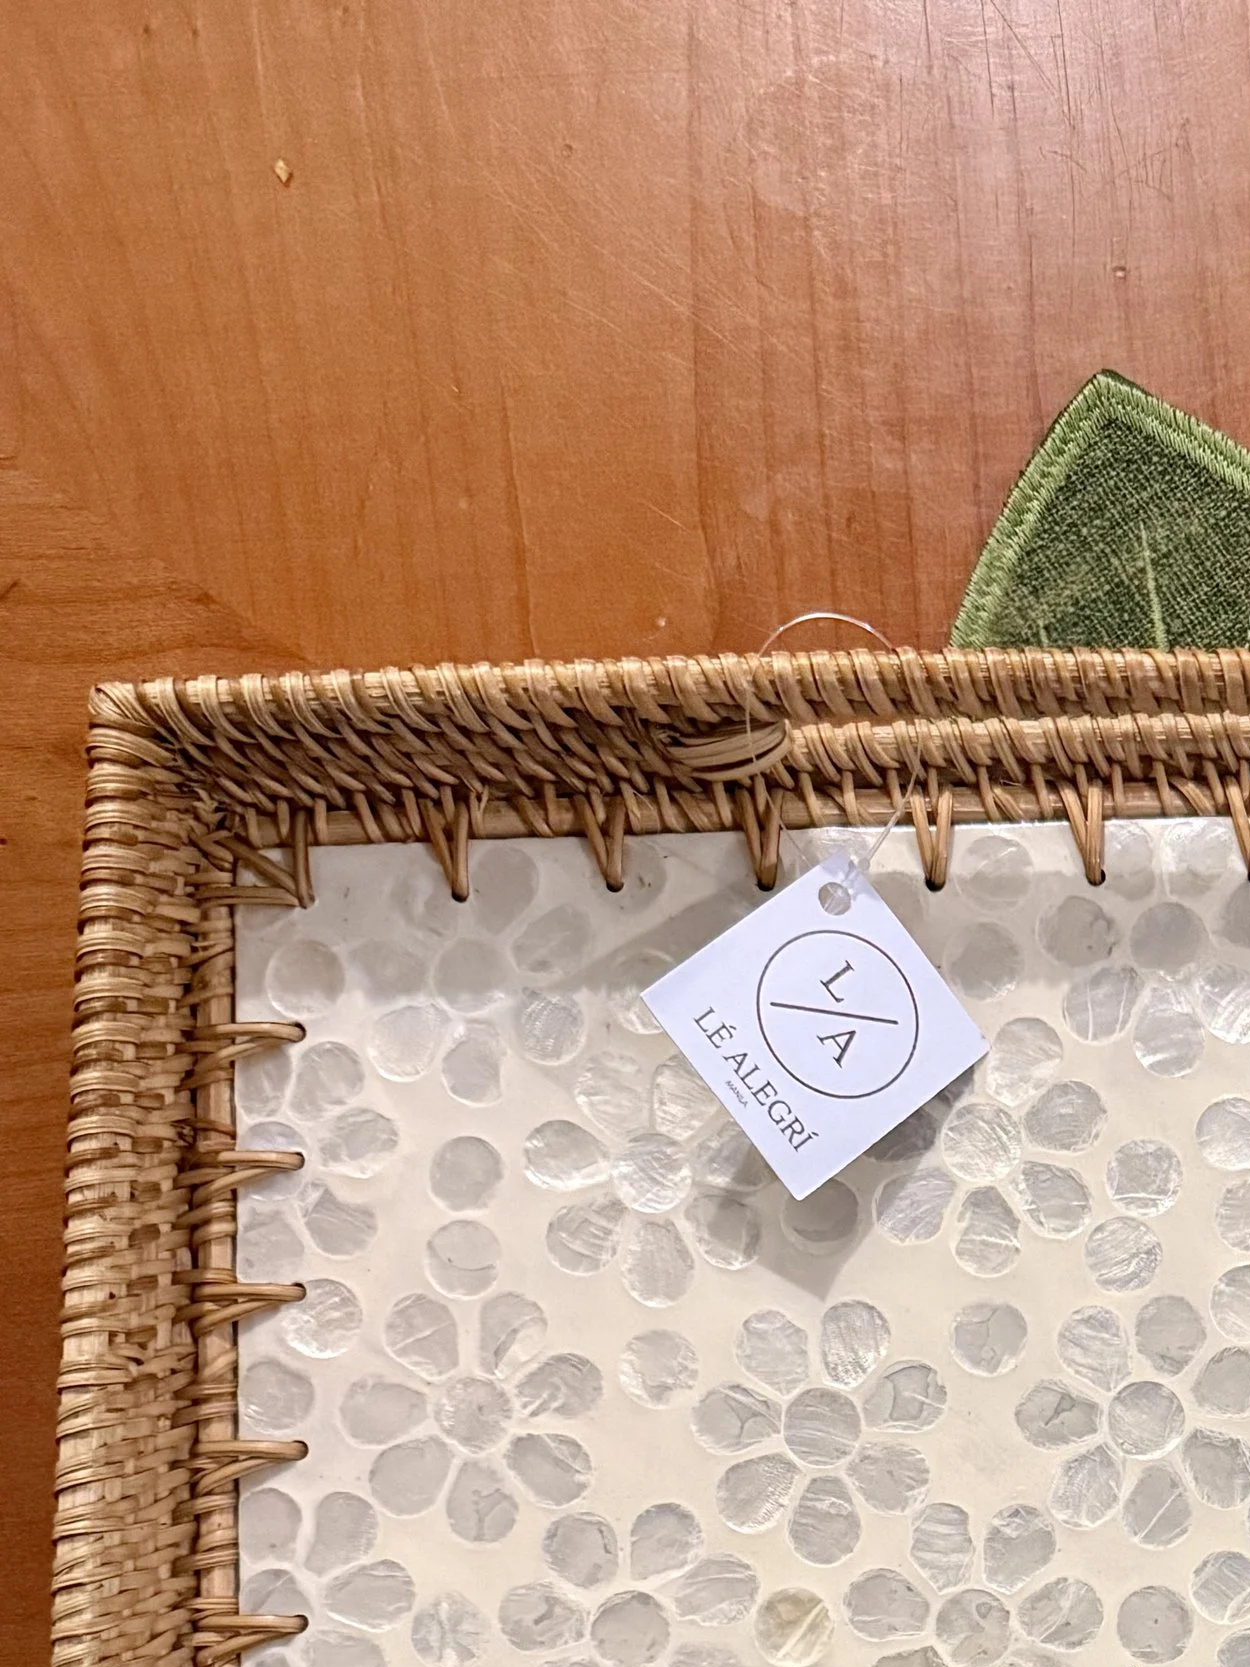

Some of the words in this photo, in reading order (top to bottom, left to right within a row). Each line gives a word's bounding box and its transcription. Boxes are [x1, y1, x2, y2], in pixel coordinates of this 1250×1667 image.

[820, 960, 854, 1003] L
[816, 1030, 856, 1068] A
[694, 1006, 737, 1049] LÉ
[722, 1052, 819, 1152] ALEGRÍ
